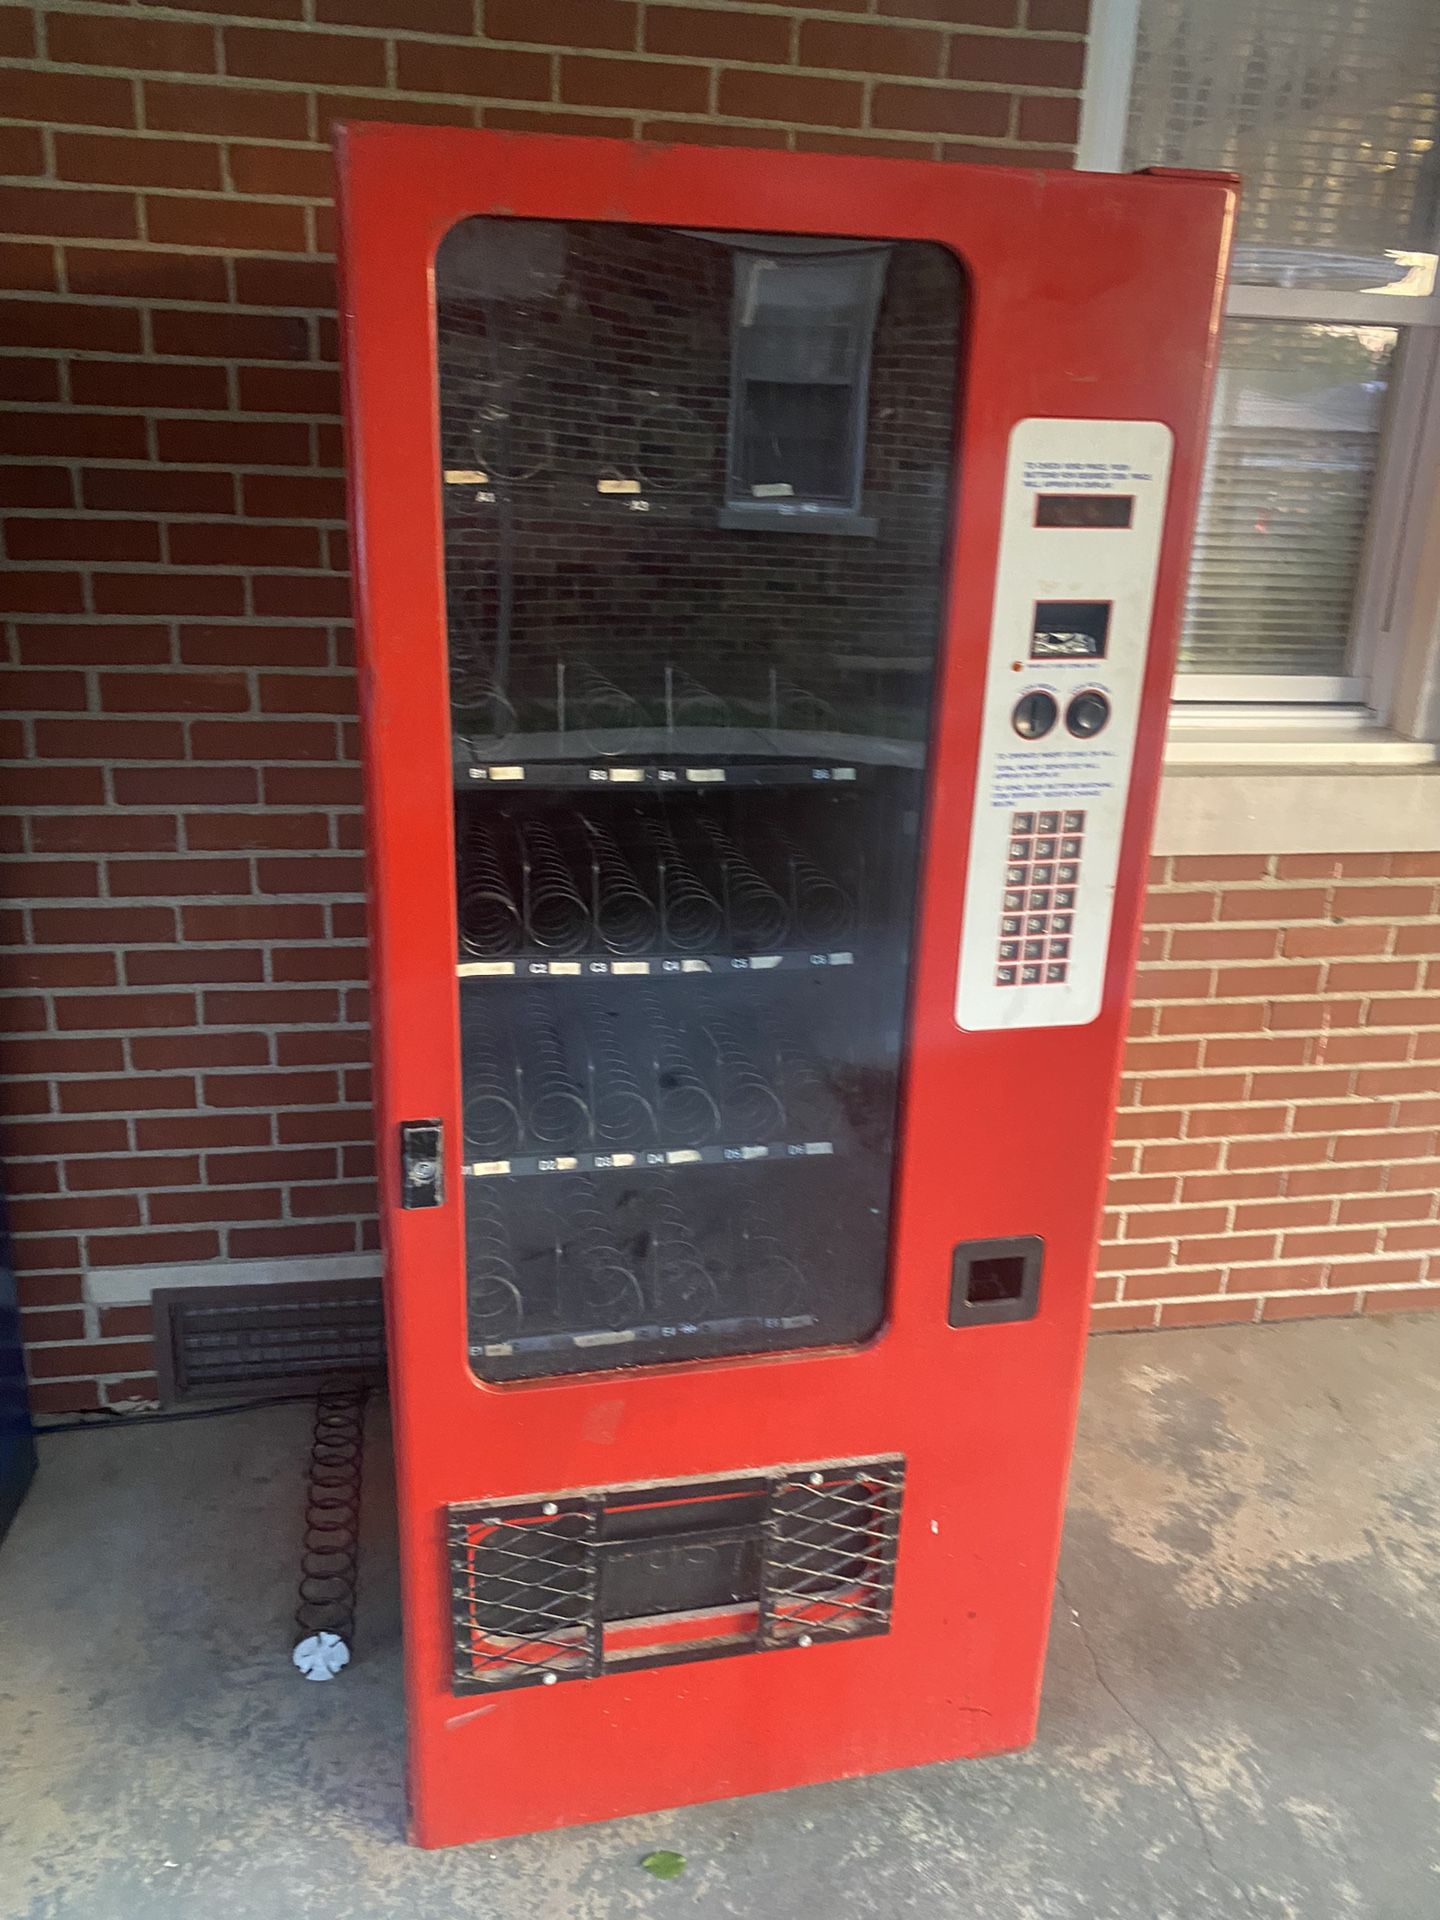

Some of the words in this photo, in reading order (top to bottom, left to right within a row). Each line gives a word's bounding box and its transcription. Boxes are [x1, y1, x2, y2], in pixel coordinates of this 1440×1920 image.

[528, 963, 548, 974] C2
[589, 962, 608, 973] C3
[662, 960, 680, 971] C4
